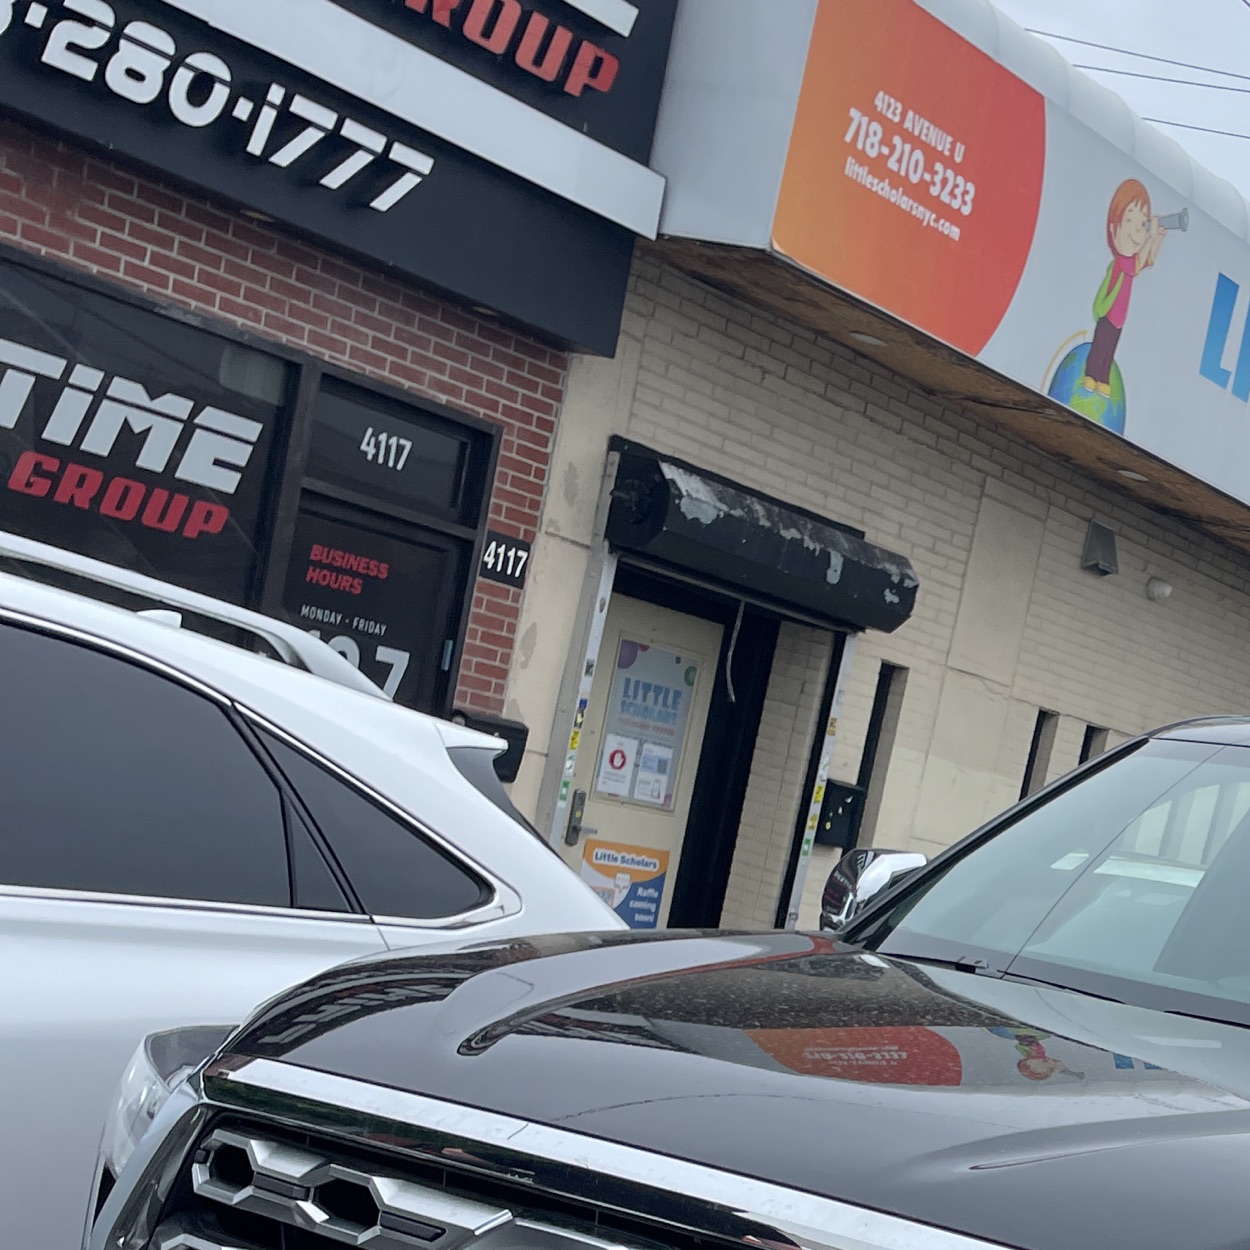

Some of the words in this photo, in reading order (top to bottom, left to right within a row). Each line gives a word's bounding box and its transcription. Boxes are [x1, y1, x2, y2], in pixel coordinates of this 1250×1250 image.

[874, 90, 903, 123] 4123
[903, 110, 954, 156] AVENUE
[954, 142, 965, 163] U
[844, 107, 975, 216] 718-210-3233
[844, 156, 960, 241] littlescholarsnyc.com
[360, 427, 412, 470] 4117
[8, 451, 229, 539] GROUP
[309, 544, 390, 579] BUSINESS
[483, 541, 528, 577] 4117
[306, 566, 363, 595] HOURS
[300, 604, 343, 625] MONDAY
[352, 617, 387, 636] FRIDAY
[622, 677, 682, 711] LITTLE
[594, 851, 619, 863] Little
[619, 855, 657, 870] Scholars
